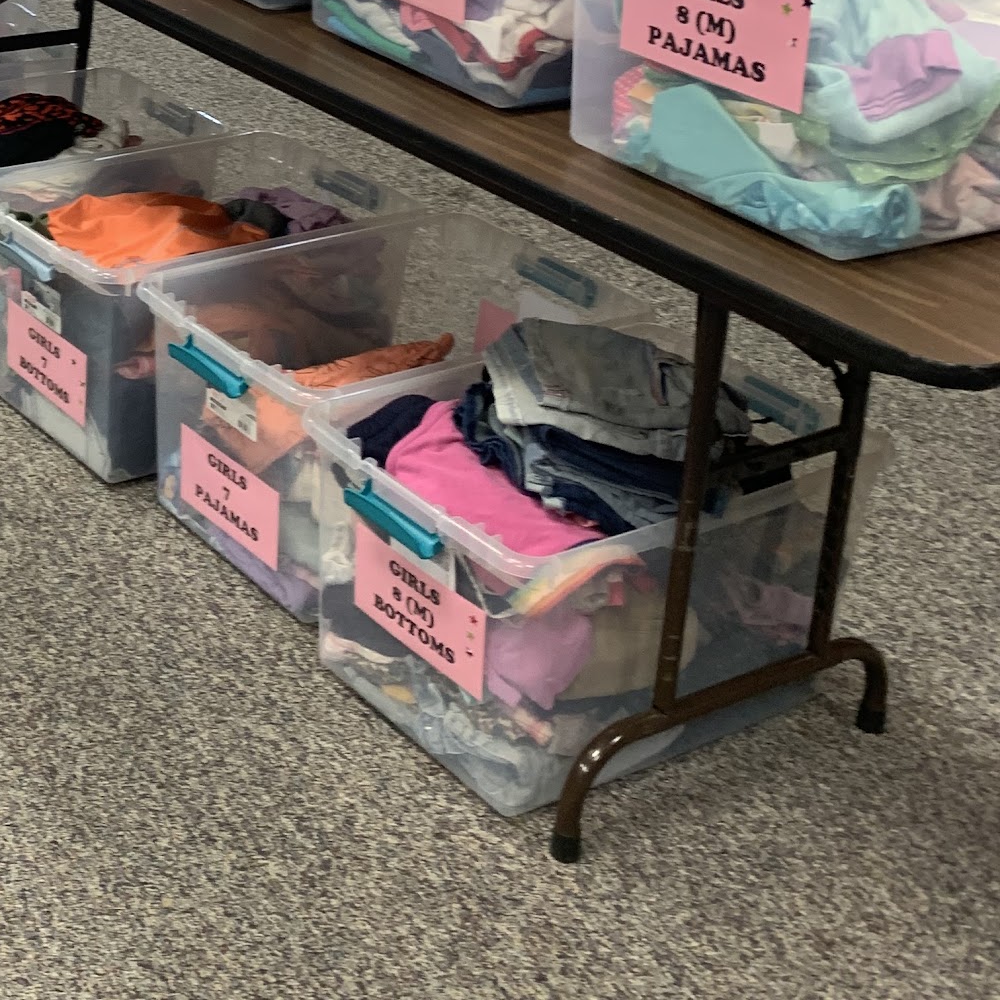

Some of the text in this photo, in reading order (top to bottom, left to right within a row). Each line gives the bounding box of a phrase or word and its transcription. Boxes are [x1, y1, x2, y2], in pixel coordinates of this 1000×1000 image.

[676, 5, 736, 44] 8 (M)
[647, 25, 767, 82] PAJAMAS
[28, 327, 60, 359] GIRLS
[41, 356, 48, 369] 7
[19, 355, 70, 404] BOTTOMS
[207, 453, 248, 490] GIRLS
[194, 484, 259, 541] PAJAMAS
[222, 486, 231, 500] 7
[388, 559, 441, 606] GIRLS
[392, 586, 435, 628] 8 (M)
[373, 593, 455, 664] BOTTOMS
